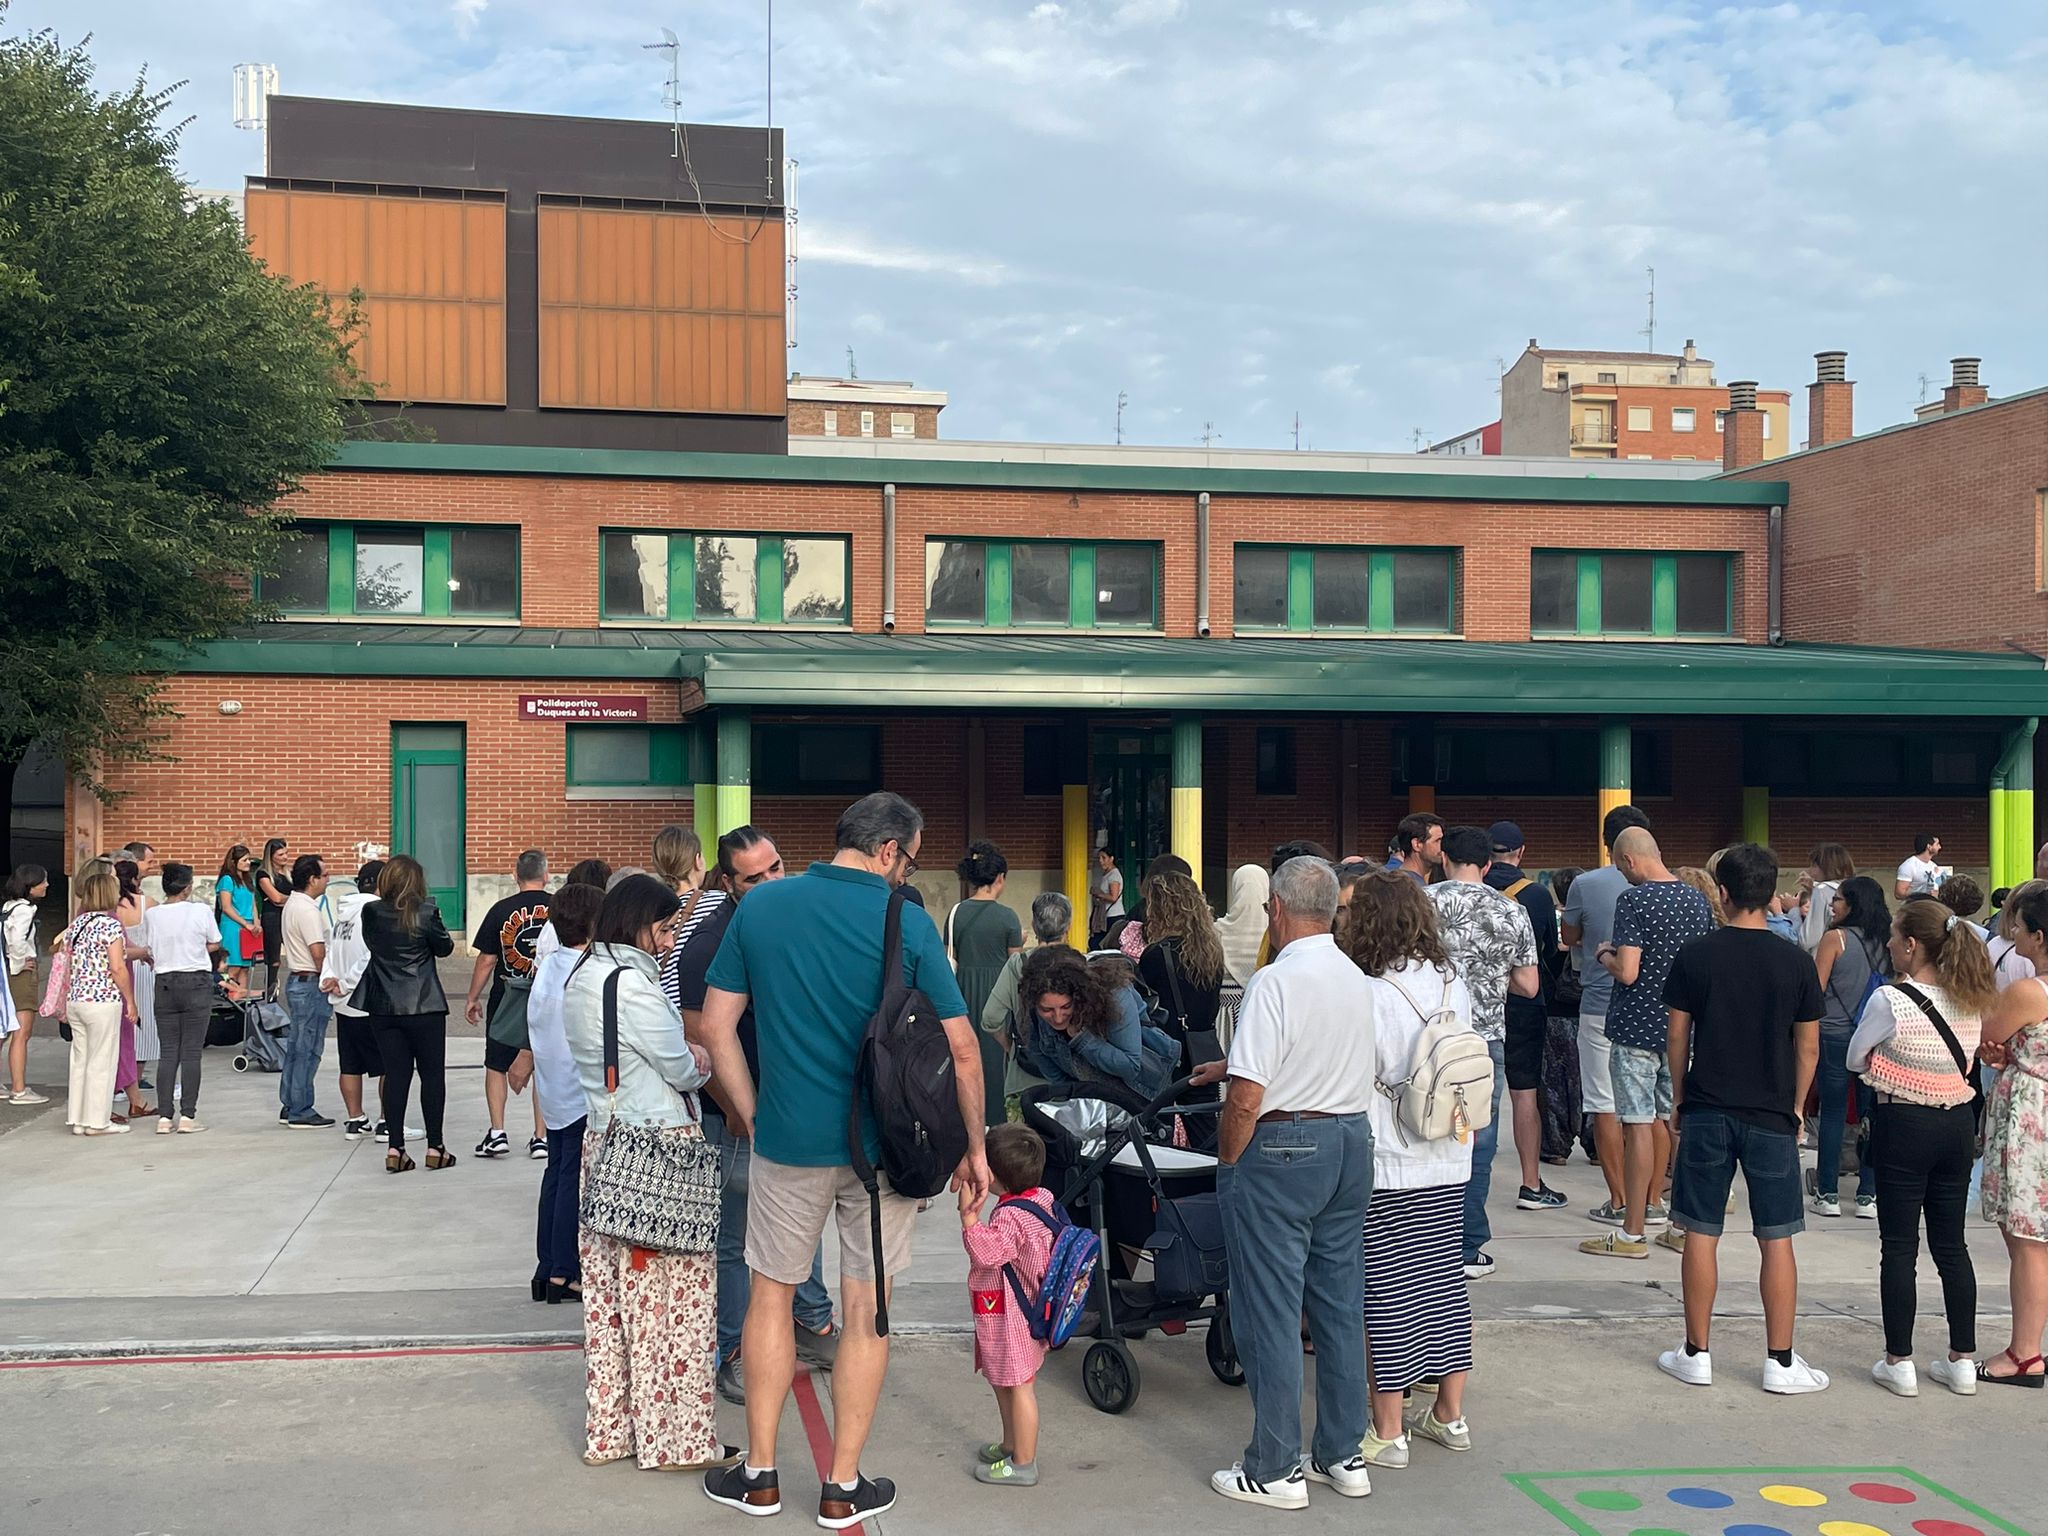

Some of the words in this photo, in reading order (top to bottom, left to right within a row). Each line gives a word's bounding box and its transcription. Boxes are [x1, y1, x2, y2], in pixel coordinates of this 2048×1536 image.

[537, 699, 599, 708] Polideportivo
[537, 709, 576, 718] Duquesa
[578, 709, 590, 717] de
[592, 709, 600, 717] la
[602, 709, 638, 717] Victoria
